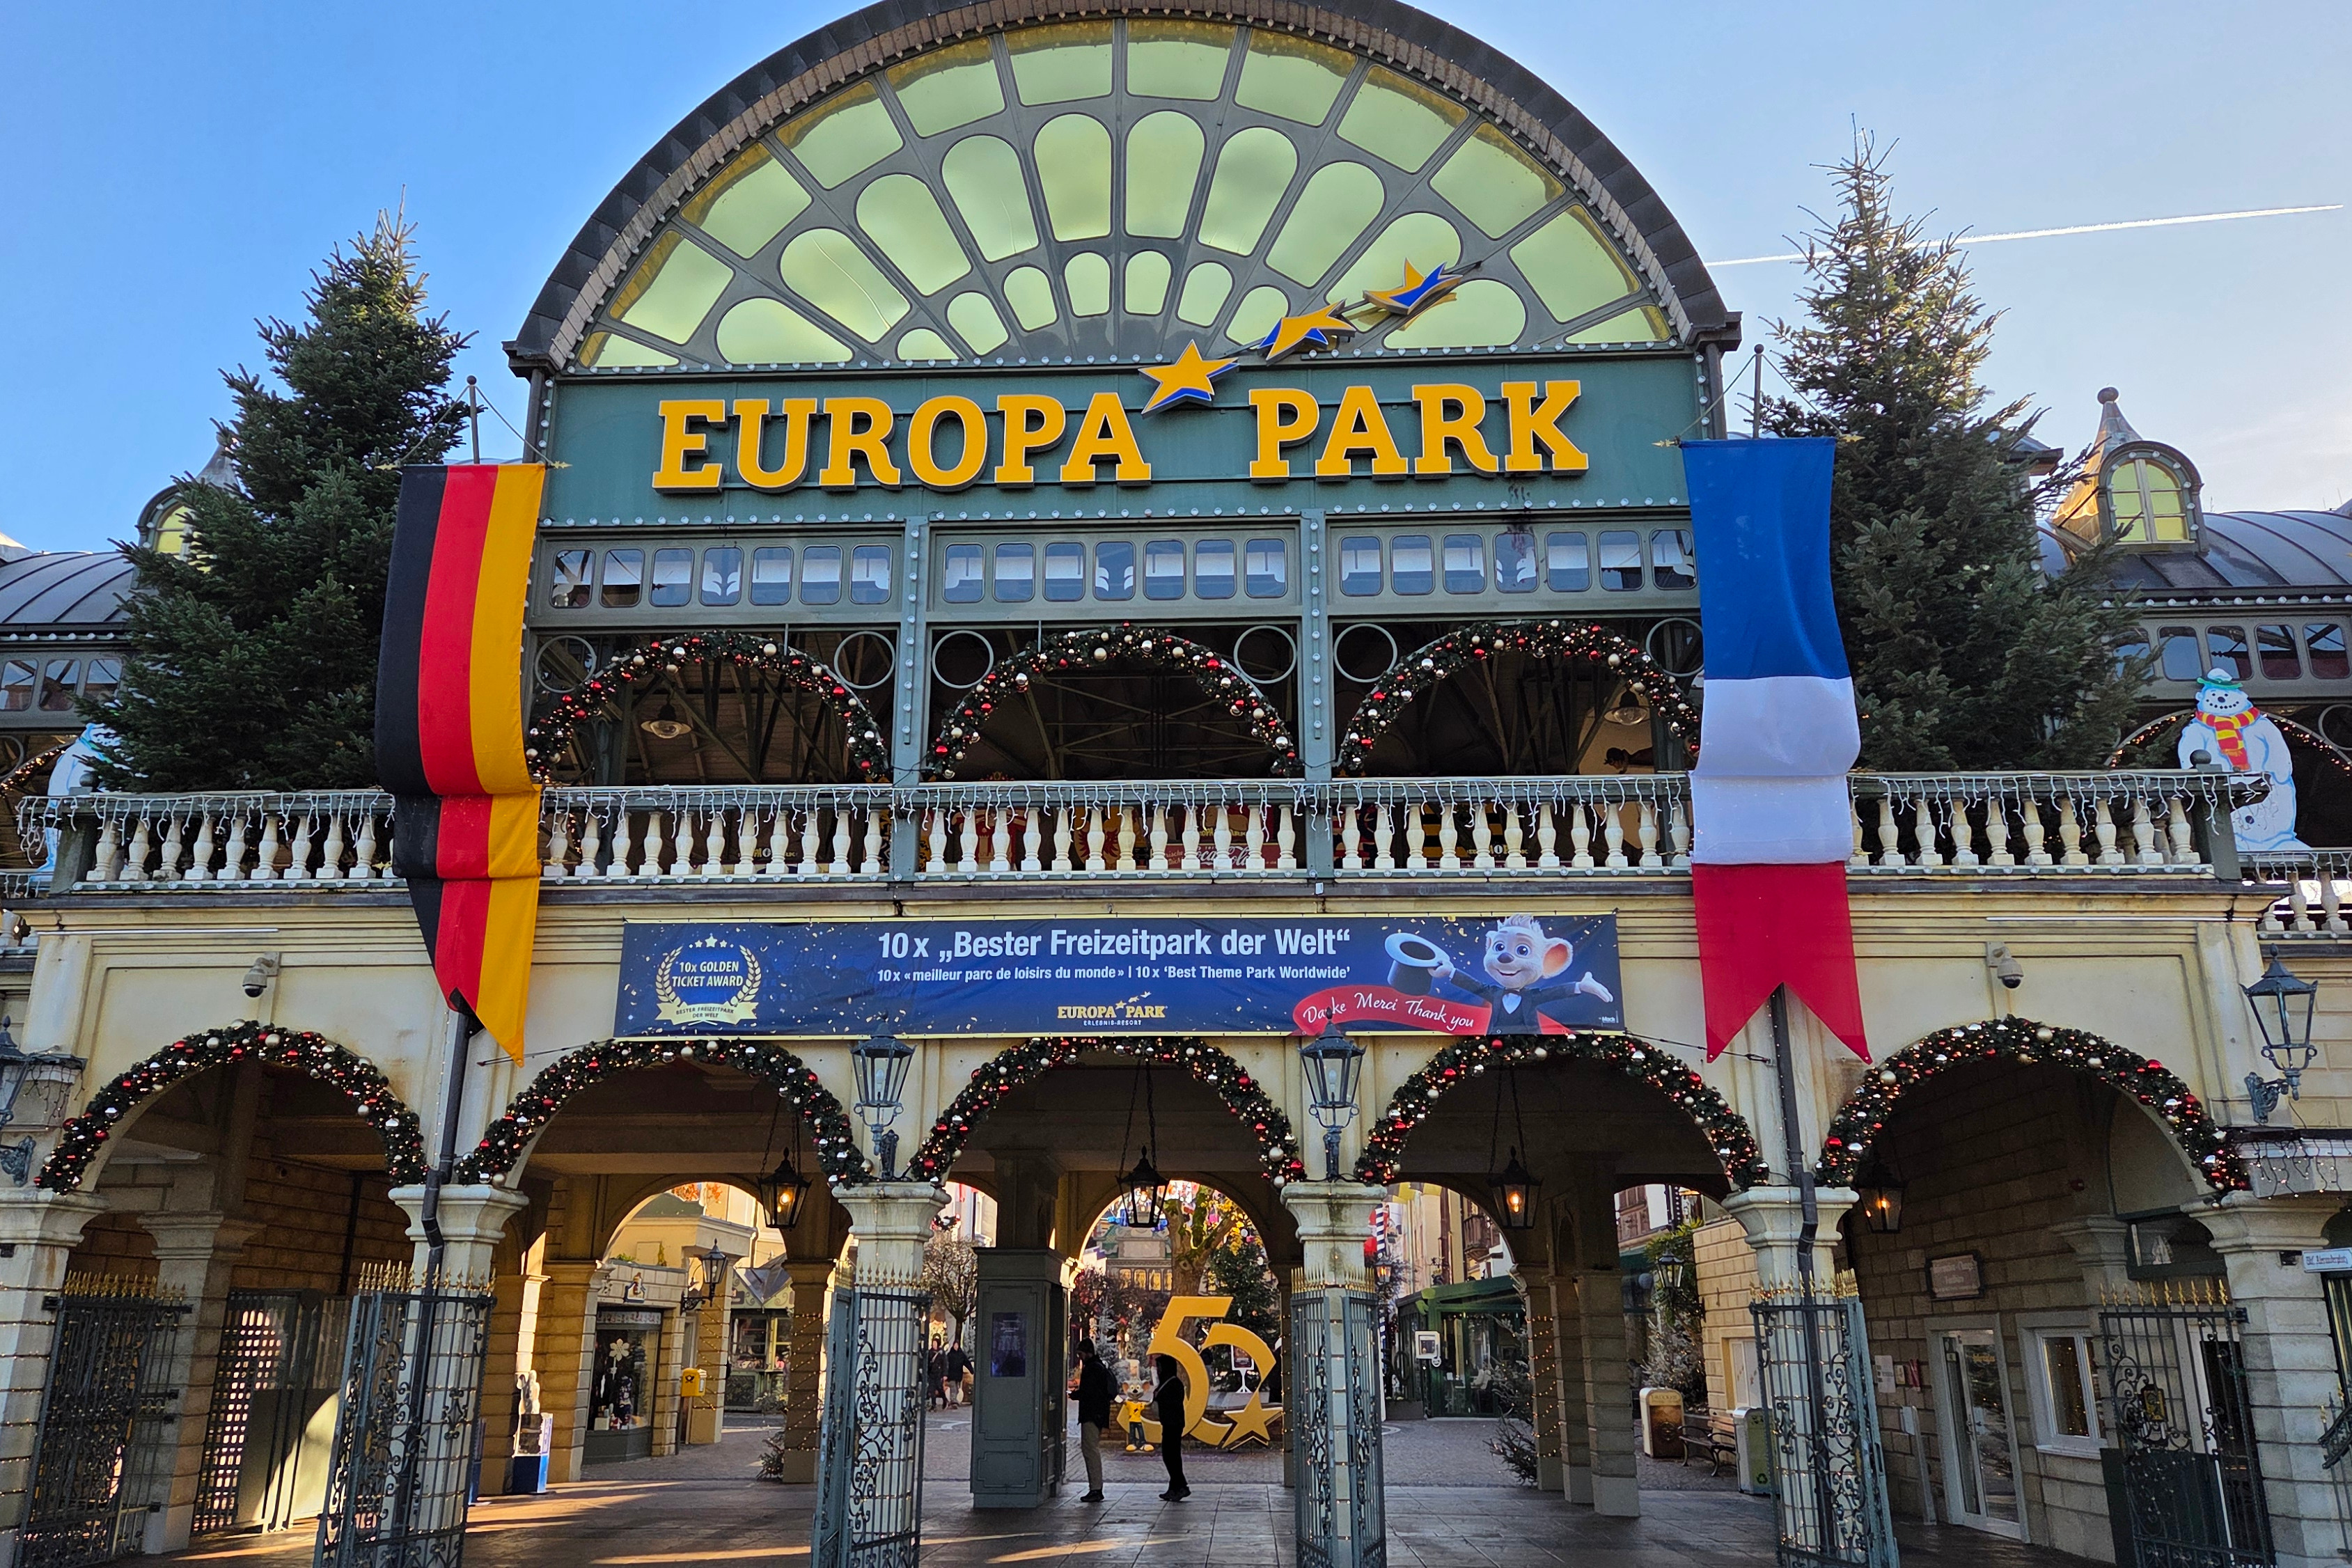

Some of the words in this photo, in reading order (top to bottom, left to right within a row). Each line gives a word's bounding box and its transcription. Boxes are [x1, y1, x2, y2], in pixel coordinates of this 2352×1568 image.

[652, 392, 1153, 490] EUROPA
[1248, 379, 1590, 480] PARK
[939, 931, 1042, 963] „Bester
[1050, 928, 1212, 961] Freizeitpark
[1221, 928, 1267, 955] der
[1274, 927, 1351, 955] Welt“
[679, 962, 697, 973] 10x
[700, 961, 739, 973] GOLDEN
[964, 969, 994, 983] parc
[996, 967, 1011, 980] de
[1014, 966, 1052, 980] loisirs
[1055, 966, 1071, 979] du
[1200, 966, 1242, 979] Theme
[1246, 966, 1276, 978] Park
[672, 975, 705, 987] TICKET
[706, 975, 744, 987] AWARD
[675, 1007, 696, 1015] BESTER
[697, 1005, 735, 1014] FREIZEITPARK
[1057, 1006, 1117, 1019] EUROPA
[1125, 1005, 1166, 1018] PARK
[1302, 996, 1347, 1024] Dake
[1354, 992, 1399, 1011] Merci
[1405, 999, 1447, 1024] Thank
[1445, 1016, 1475, 1031] you
